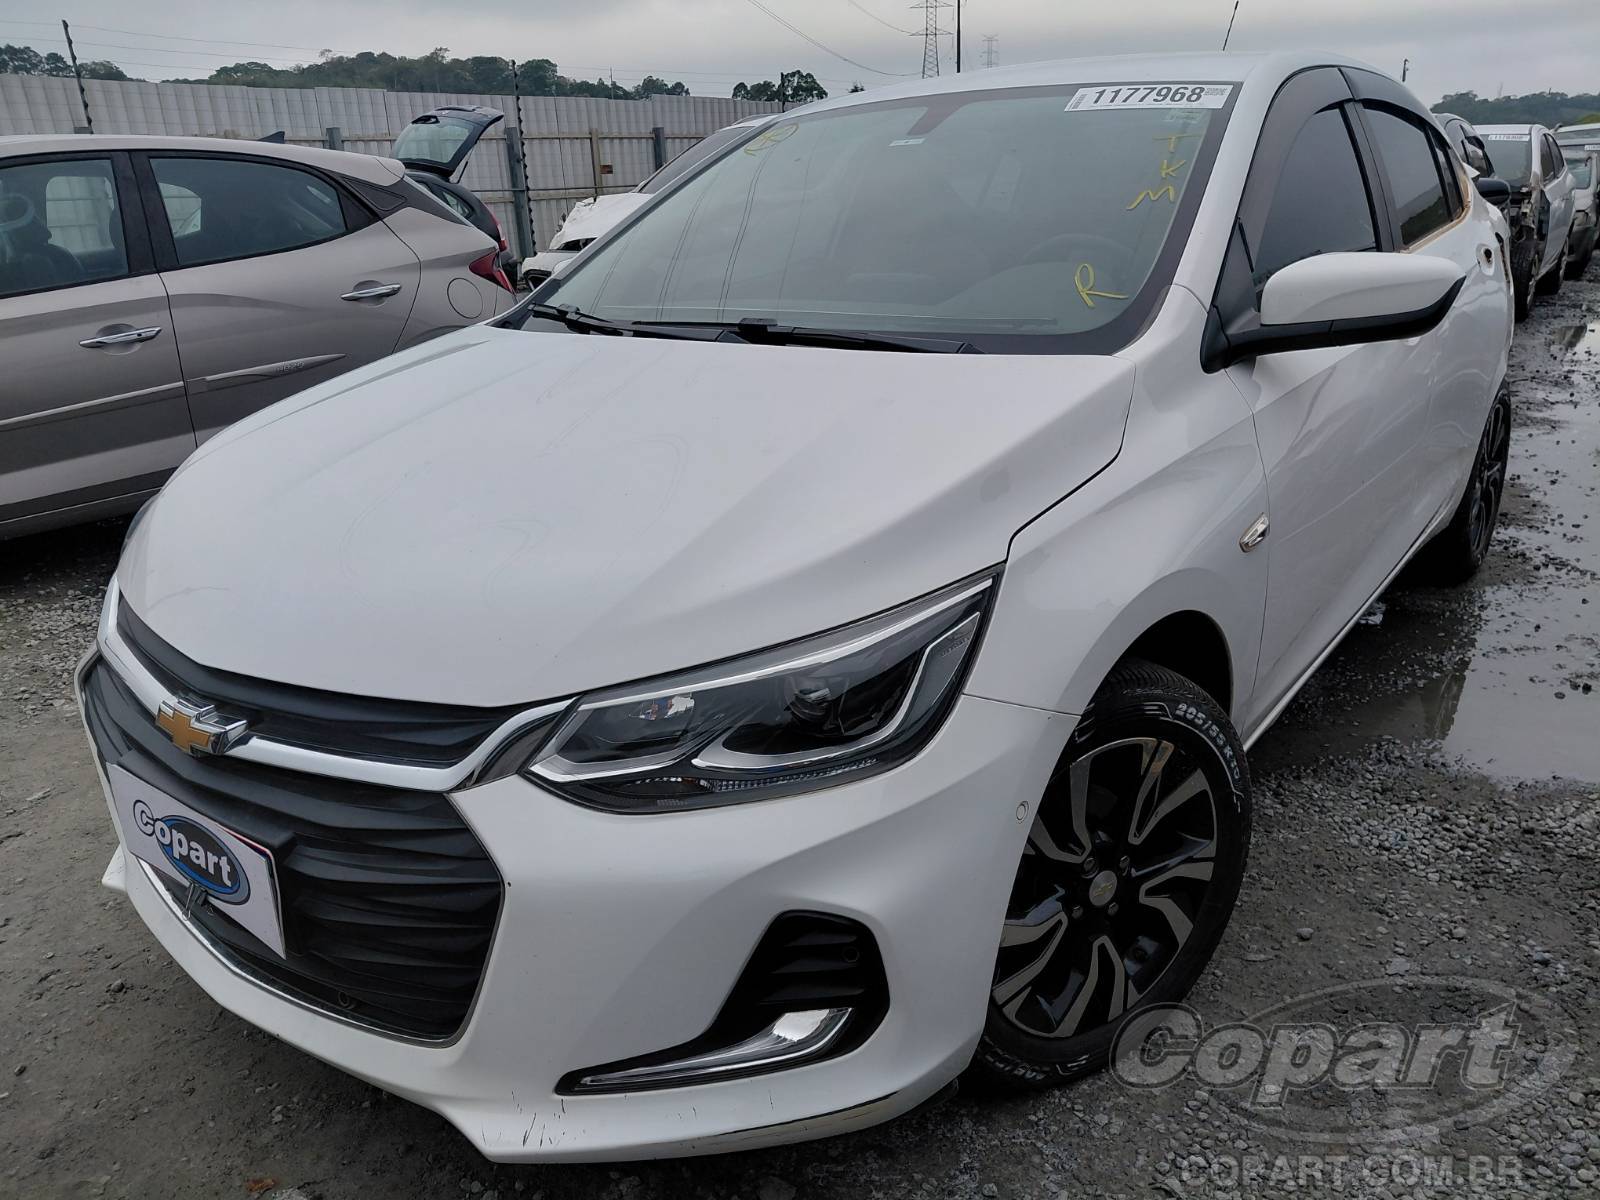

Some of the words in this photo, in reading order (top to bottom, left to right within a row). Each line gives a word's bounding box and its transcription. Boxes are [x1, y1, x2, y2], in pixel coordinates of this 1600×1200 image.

[1093, 86, 1205, 104] 1177968
[1074, 263, 1129, 308] R
[132, 799, 233, 887] Copart
